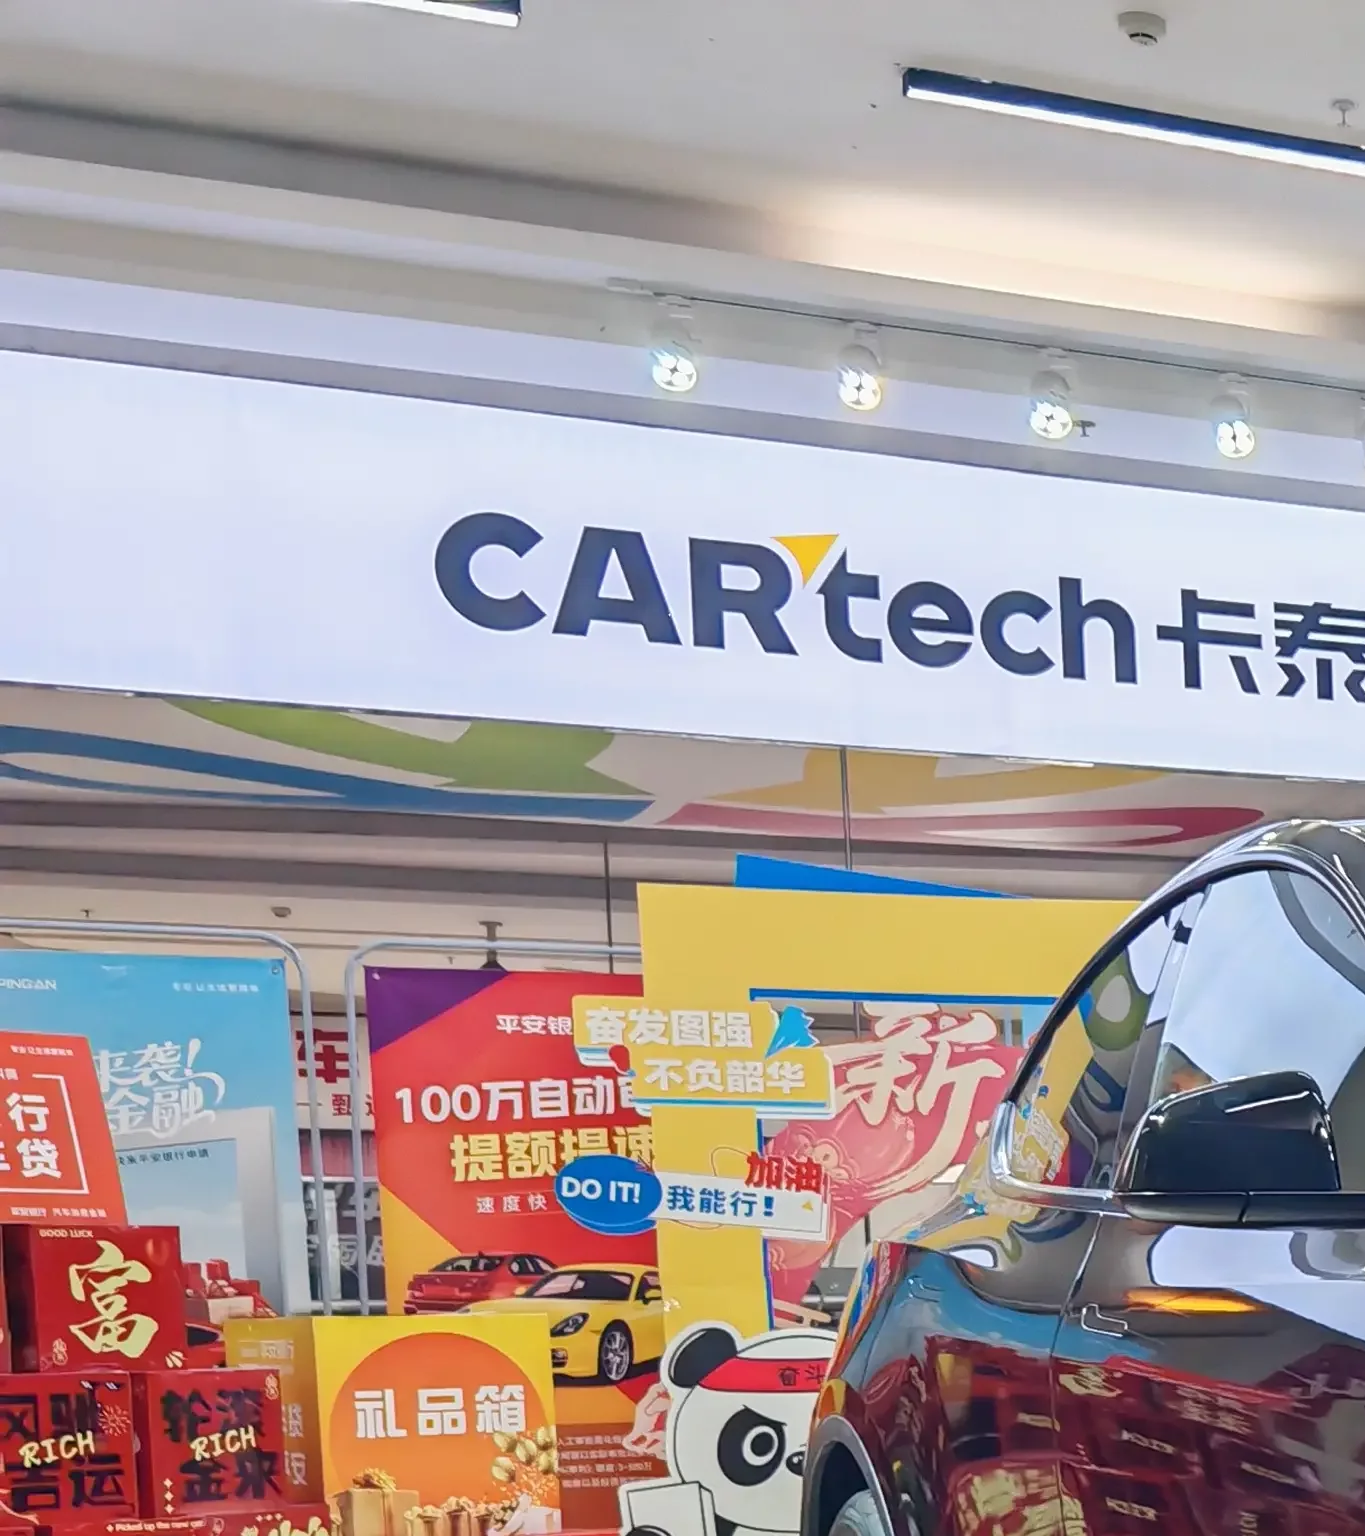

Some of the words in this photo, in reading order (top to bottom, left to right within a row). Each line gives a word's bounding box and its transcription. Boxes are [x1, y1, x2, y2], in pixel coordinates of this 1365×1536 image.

[434, 511, 1138, 684] CARtech
[584, 1005, 754, 1050] 奋发图强
[644, 1057, 806, 1095] 不负韶华
[561, 1177, 602, 1200] DO
[609, 1180, 641, 1204] IT!
[745, 1151, 823, 1194] 加油
[68, 1239, 159, 1359] 富
[353, 1384, 527, 1439] 礼品箱
[18, 1429, 96, 1468] RICH
[189, 1424, 257, 1462] RICH
